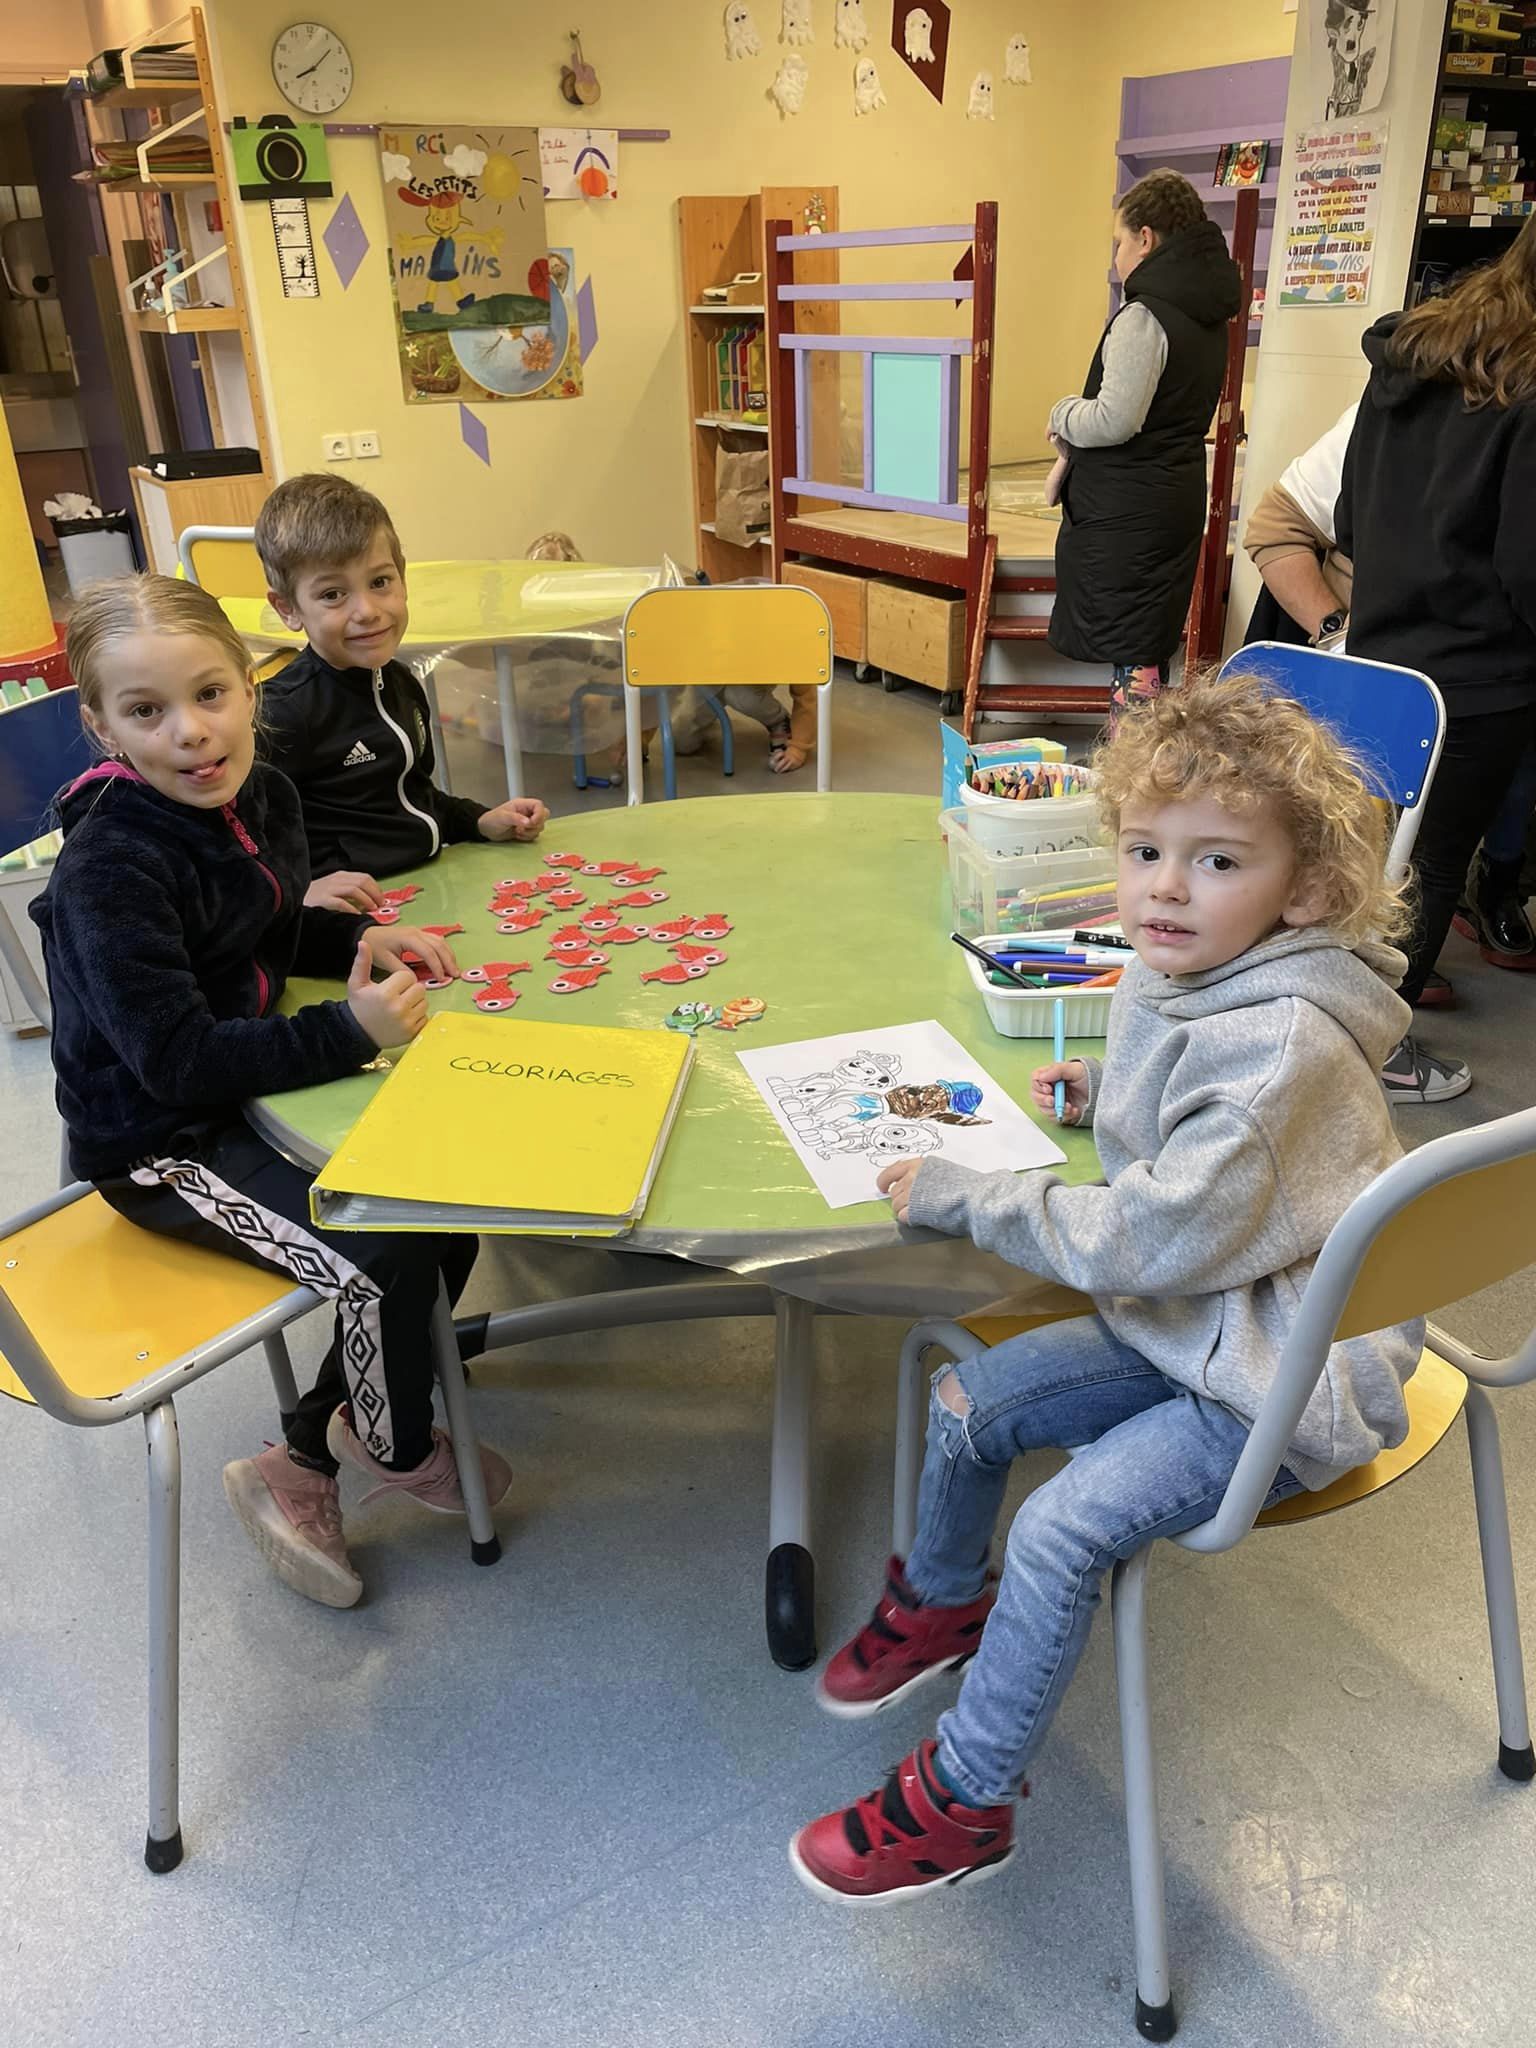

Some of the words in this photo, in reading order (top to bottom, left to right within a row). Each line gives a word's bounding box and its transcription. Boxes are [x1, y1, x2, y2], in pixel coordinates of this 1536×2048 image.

[384, 133, 447, 155] MRCi
[409, 177, 434, 198] LES
[1364, 182, 1377, 190] PAS
[1327, 223, 1338, 233] LES
[1339, 221, 1365, 233] ADULTES
[343, 752, 377, 766] adidas
